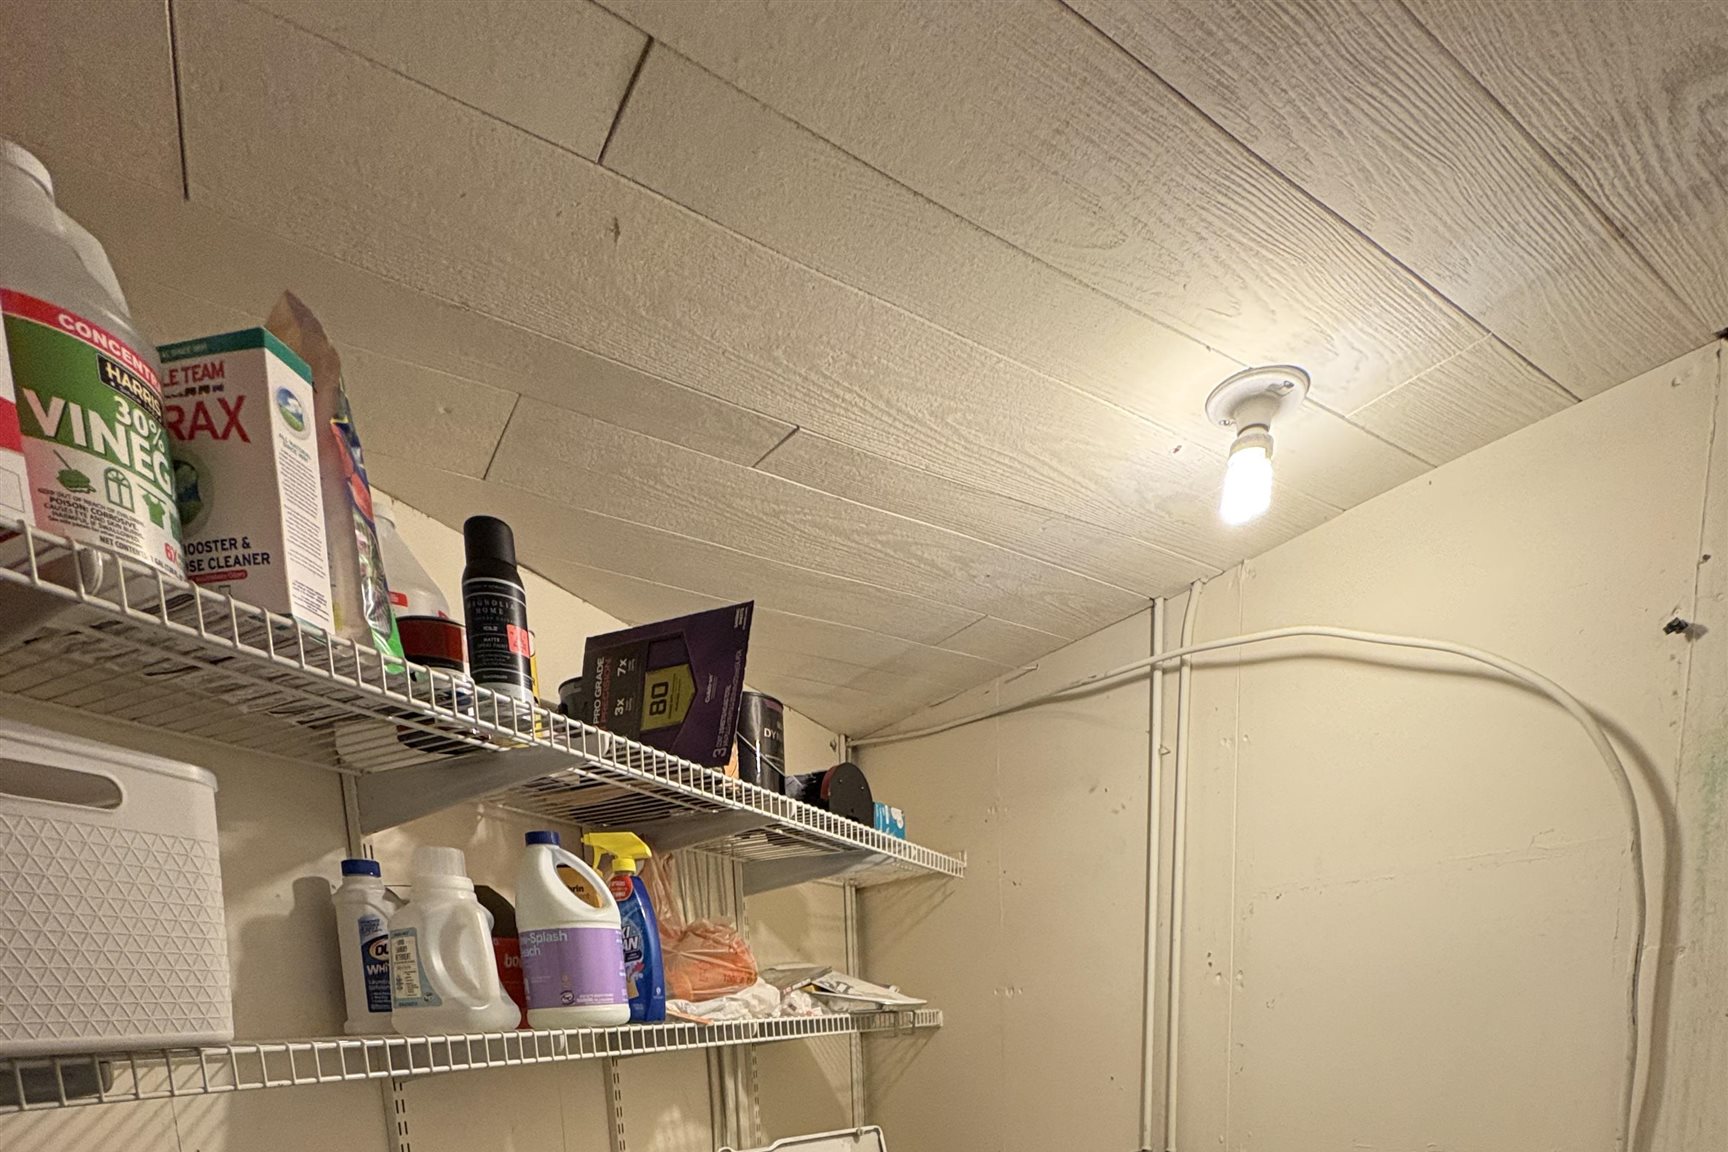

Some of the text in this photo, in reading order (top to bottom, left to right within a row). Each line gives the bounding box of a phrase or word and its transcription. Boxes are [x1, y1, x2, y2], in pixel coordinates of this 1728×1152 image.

[181, 360, 225, 384] TEAM
[106, 361, 162, 417] HARRIS
[114, 395, 165, 453] 30%
[241, 536, 251, 550] &
[186, 559, 205, 573] SE
[207, 552, 271, 570] CLEANER
[592, 656, 605, 725] PRO GRADE
[649, 681, 669, 716] 80
[614, 697, 625, 716] 3x
